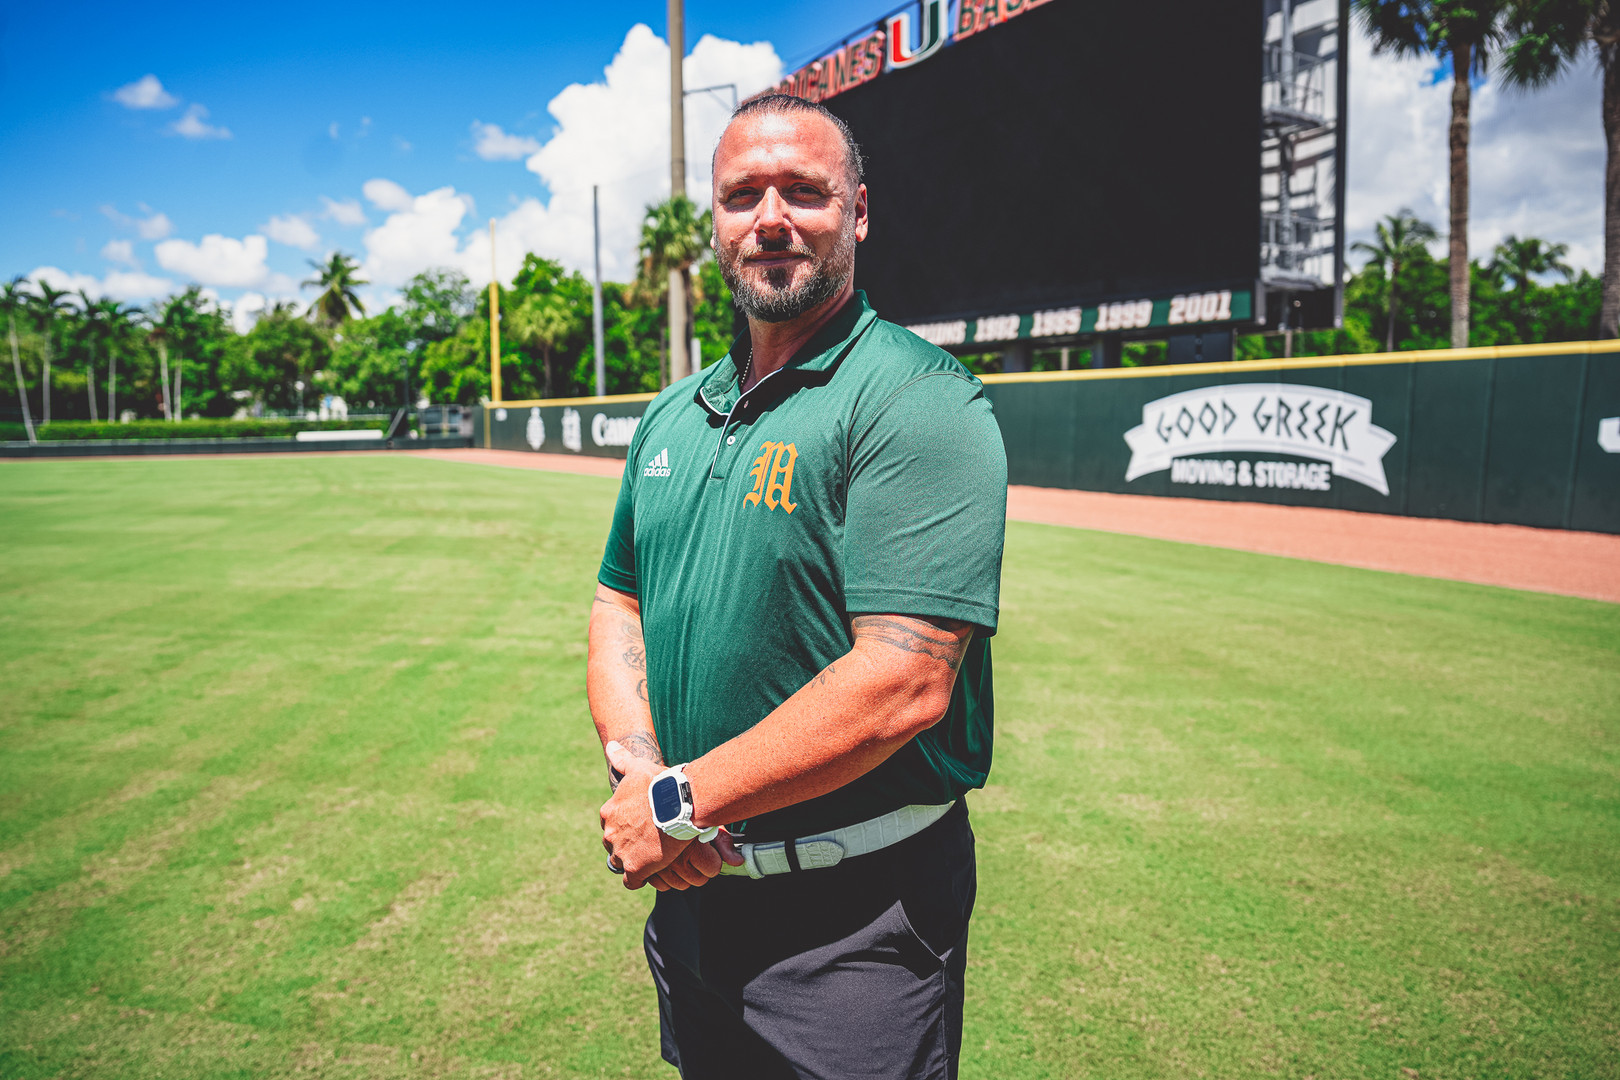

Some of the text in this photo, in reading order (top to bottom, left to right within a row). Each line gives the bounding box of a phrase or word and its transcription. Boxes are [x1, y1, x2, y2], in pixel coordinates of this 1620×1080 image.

[887, 0, 947, 68] U
[1030, 306, 1082, 338] 1985
[1095, 298, 1152, 332] 1999
[1167, 290, 1232, 326] 2001
[1155, 396, 1357, 451] GOOD GREEK
[643, 466, 671, 477] adidas
[1171, 458, 1331, 491] MOVING & STORAGE
